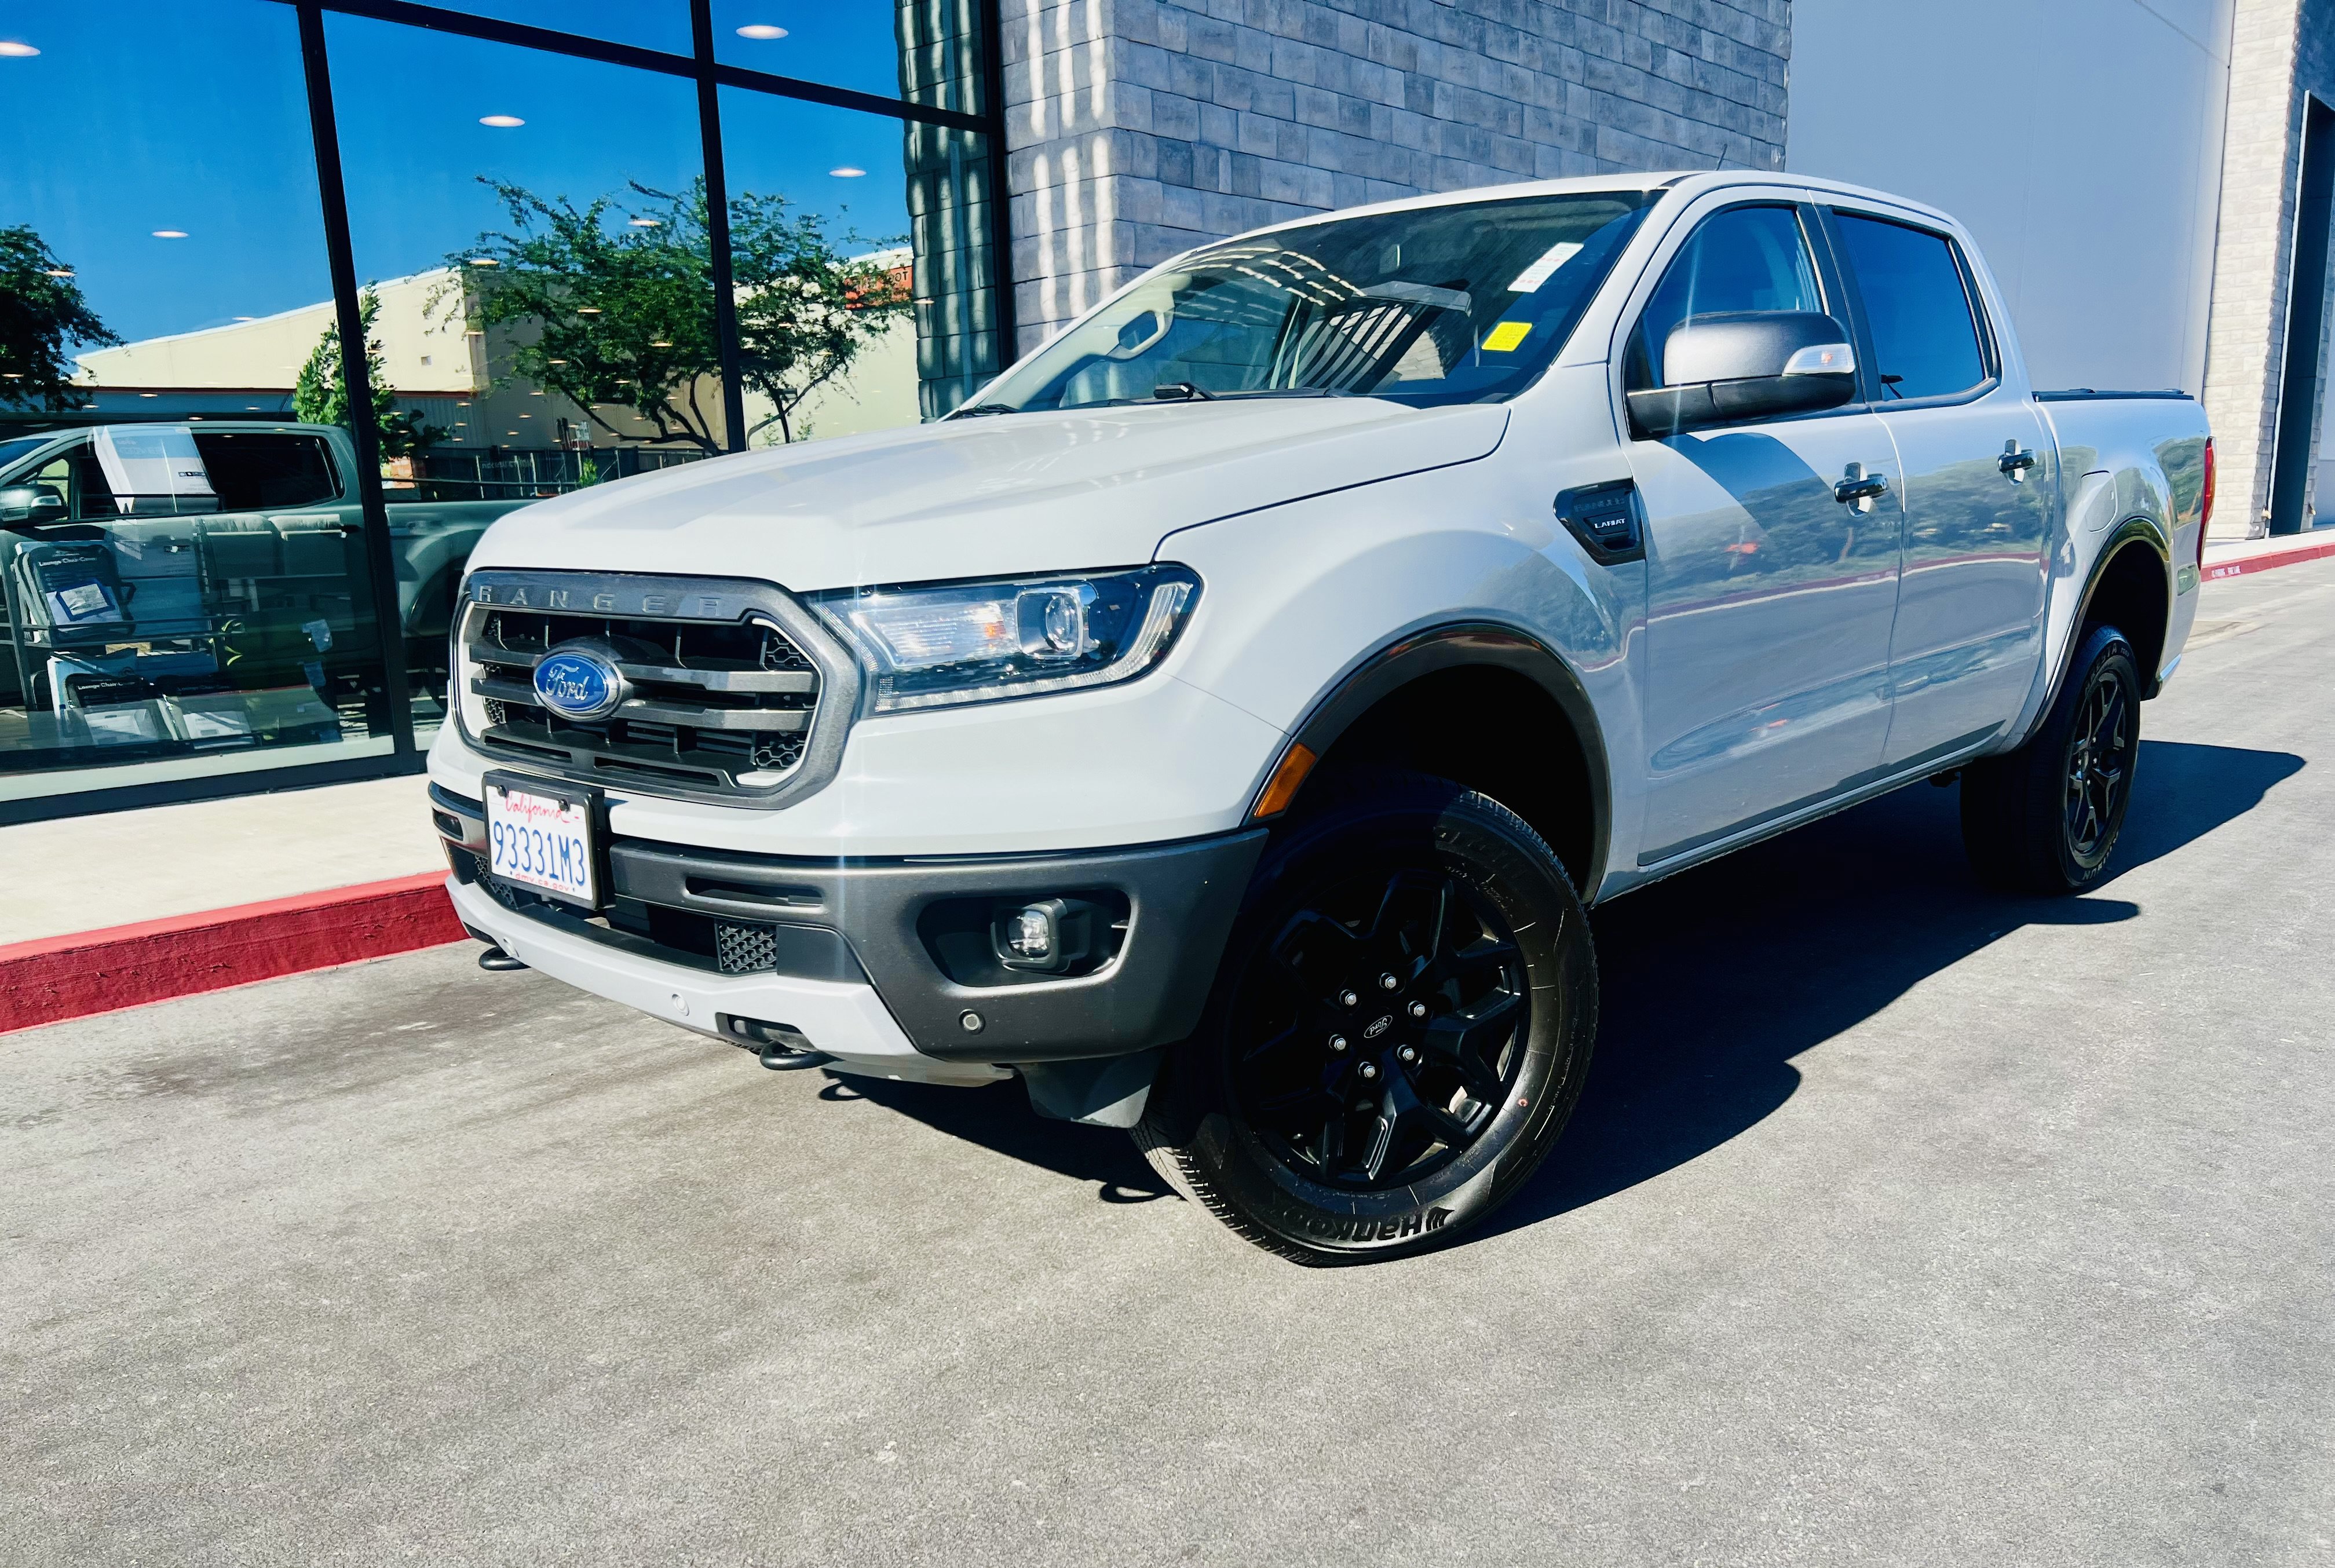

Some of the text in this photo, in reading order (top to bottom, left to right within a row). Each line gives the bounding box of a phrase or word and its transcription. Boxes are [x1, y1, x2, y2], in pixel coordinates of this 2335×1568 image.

[1594, 518, 1626, 529] LARIAT
[478, 585, 721, 617] RANGER
[546, 663, 590, 700] Ford
[506, 790, 570, 823] California
[494, 821, 585, 886] 93331M3
[515, 873, 569, 892] dmv.ca.gov
[1369, 1018, 1387, 1035] Ford
